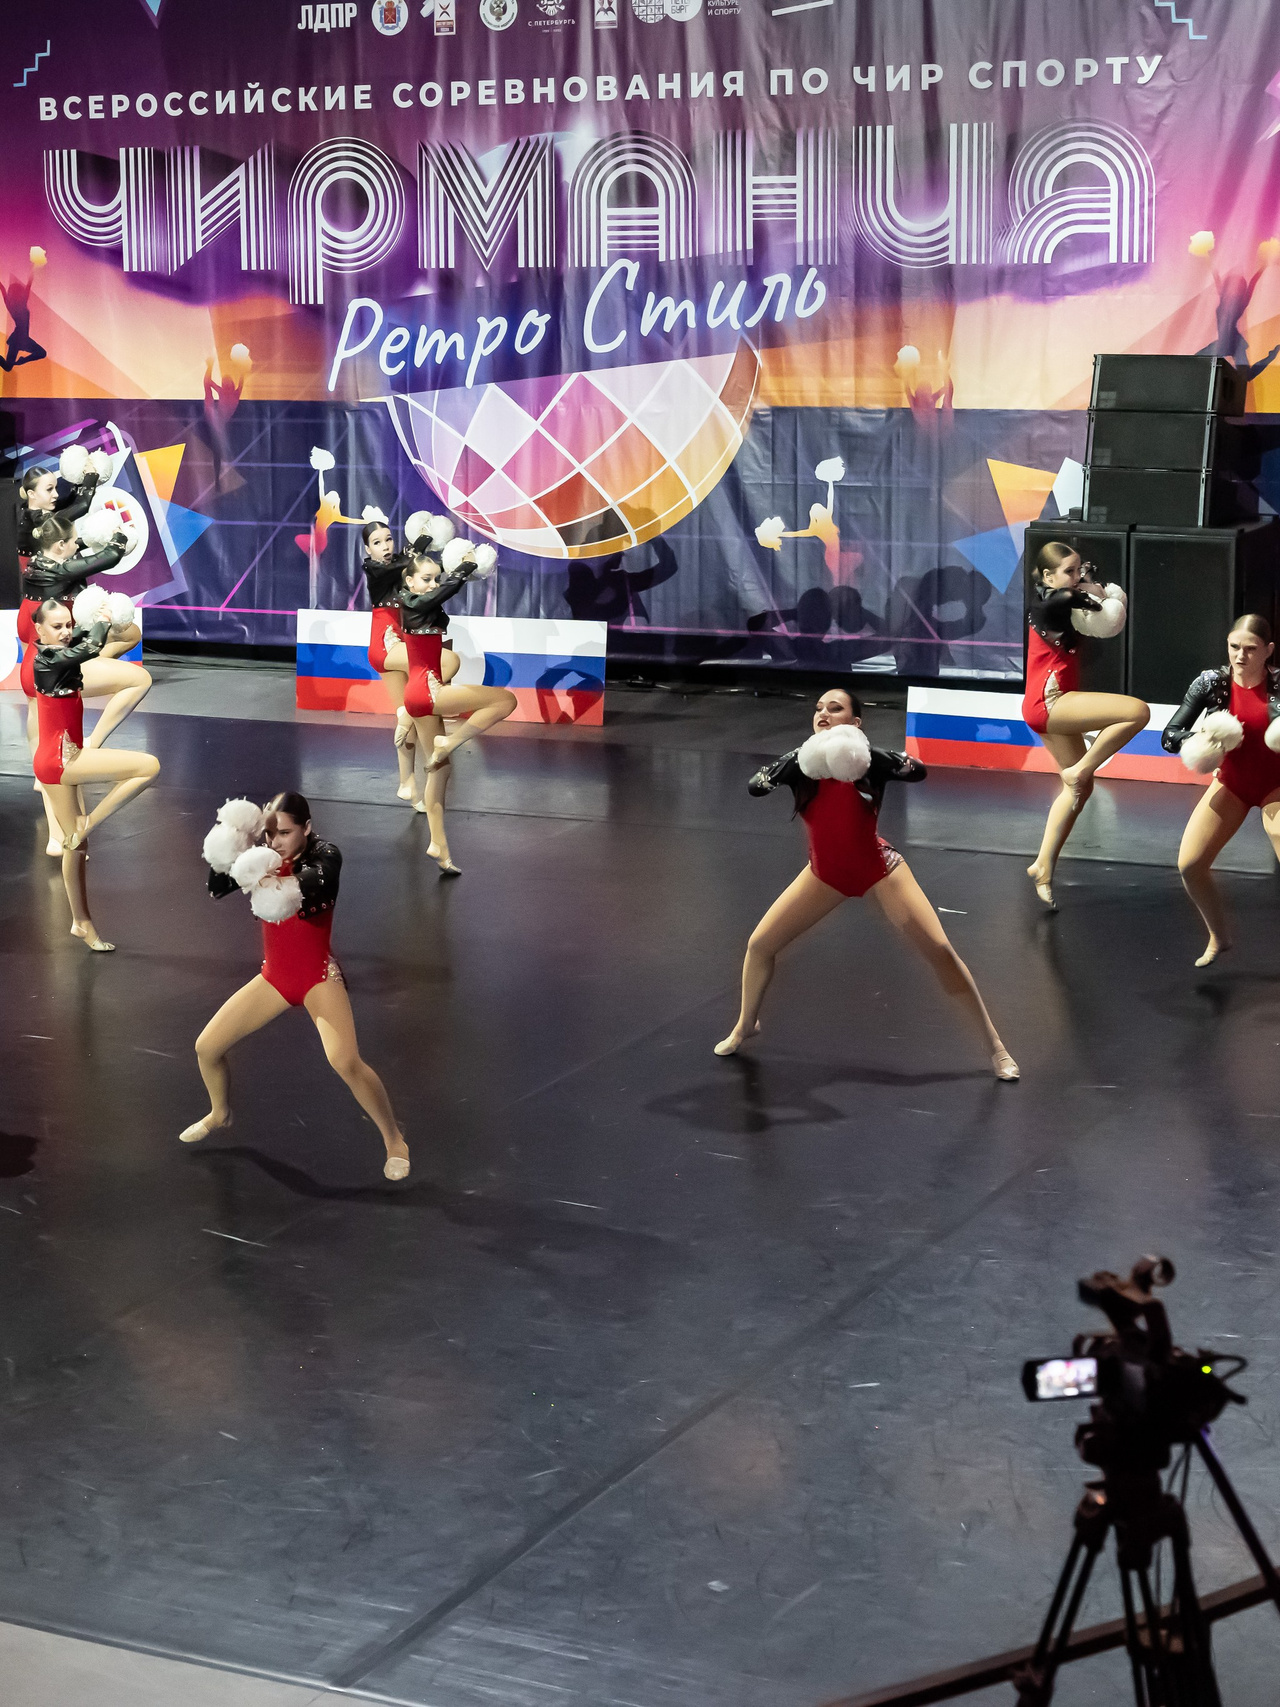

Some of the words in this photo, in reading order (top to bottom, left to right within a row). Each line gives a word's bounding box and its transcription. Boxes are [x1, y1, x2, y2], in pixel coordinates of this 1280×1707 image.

[297, 3, 358, 33] ЛДПР
[39, 82, 373, 121] ВСЕРОССИЙСКИЕ
[392, 70, 745, 109] СОРЕВНОВАНИЯ
[769, 67, 829, 95] ПО
[852, 64, 944, 92] ЧИР
[968, 55, 1163, 89] СПОРТУ
[327, 297, 552, 392] Ретро
[583, 258, 827, 354] Стиль
